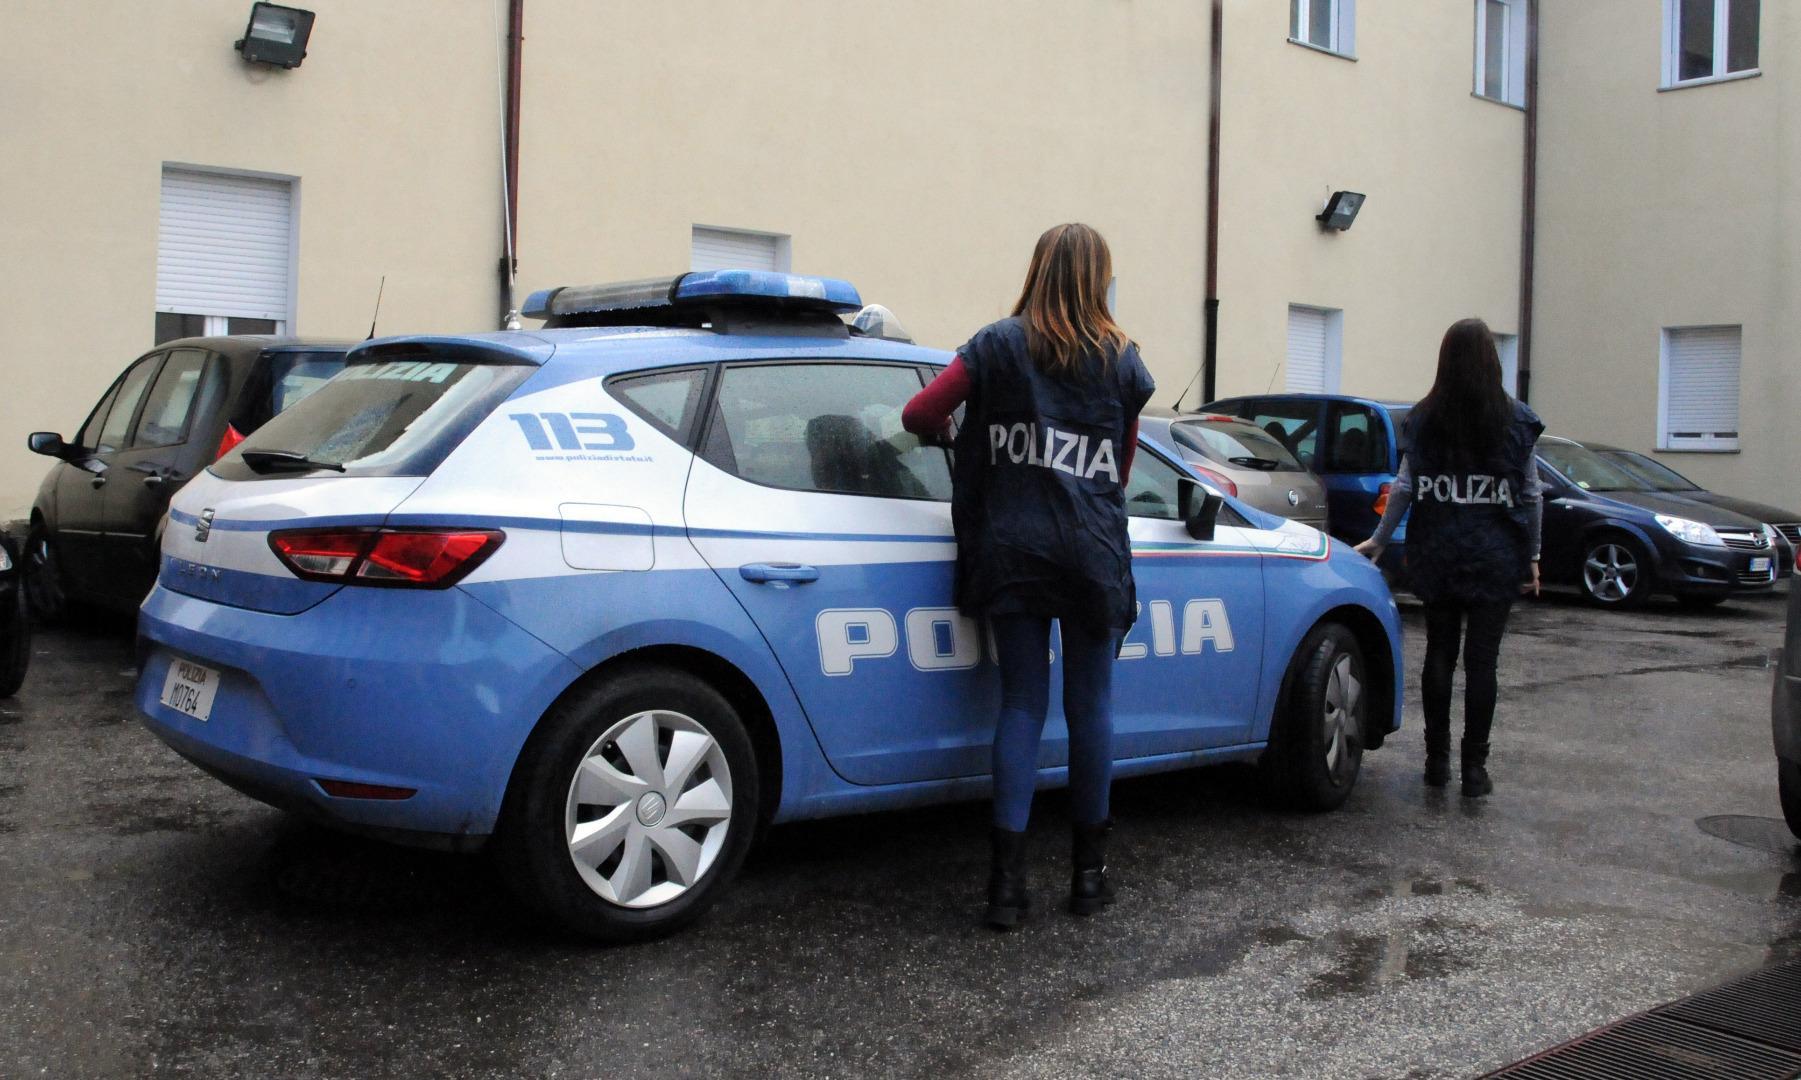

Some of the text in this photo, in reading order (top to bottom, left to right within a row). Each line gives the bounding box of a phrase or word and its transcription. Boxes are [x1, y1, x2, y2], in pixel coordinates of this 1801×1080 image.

[508, 412, 636, 451] 113
[989, 422, 1119, 483] POLIZIA
[1417, 474, 1514, 508] POLIZIA
[815, 598, 1235, 677] POIA
[178, 662, 207, 685] POLIZIA
